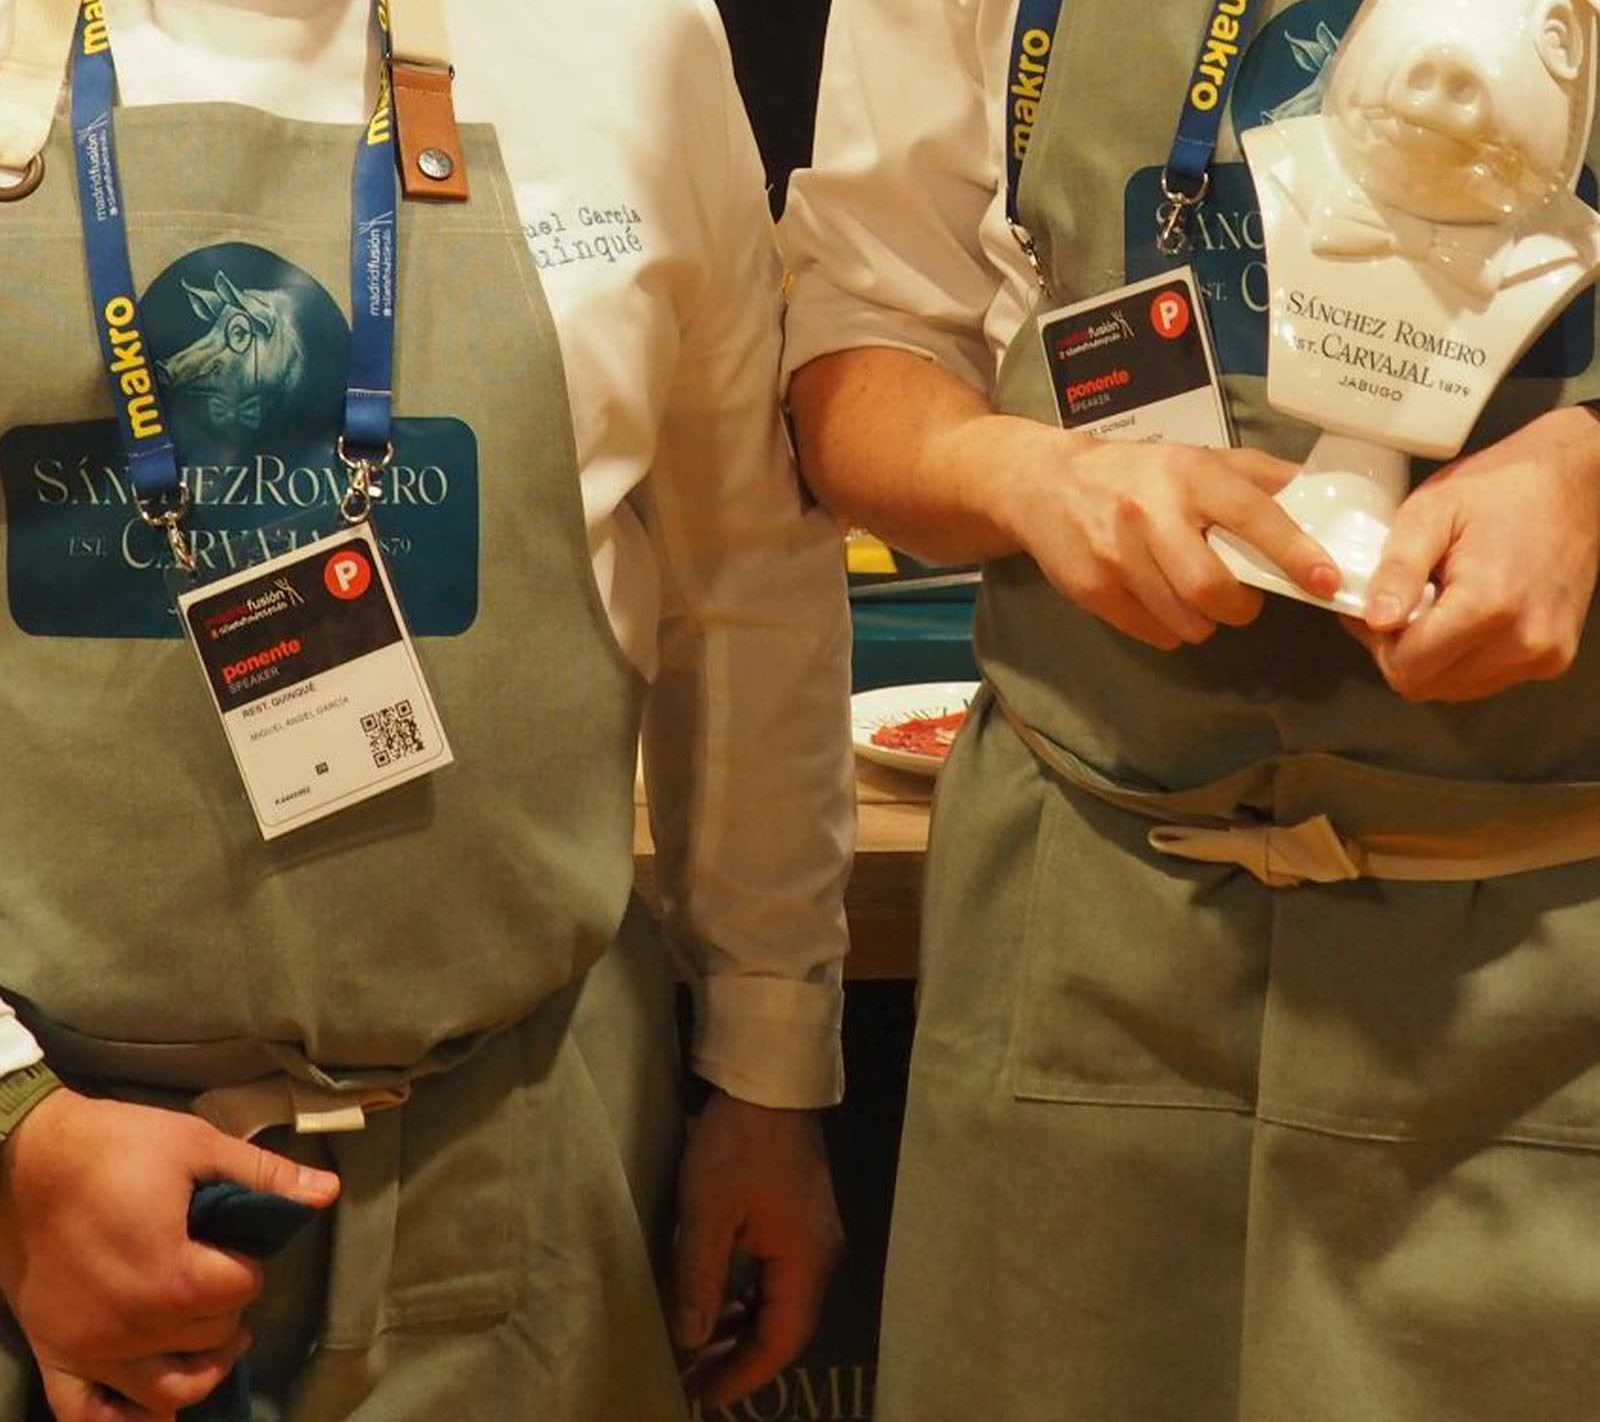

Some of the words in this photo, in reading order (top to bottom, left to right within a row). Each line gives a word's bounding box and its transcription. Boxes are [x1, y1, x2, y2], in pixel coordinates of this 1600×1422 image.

[1010, 28, 1051, 161] makro
[1159, 298, 1179, 331] P
[1286, 289, 1387, 339] SÁNCHEZ
[1394, 320, 1487, 367] ROMERO
[104, 295, 162, 439] makro
[1321, 332, 1433, 388] CARVAJAL
[1437, 379, 1472, 398] 1879
[1066, 368, 1131, 404] ponente
[1338, 375, 1404, 402] JABUGO
[333, 560, 358, 593] P
[222, 638, 302, 684] ponente
[229, 666, 280, 695] SPEAKER
